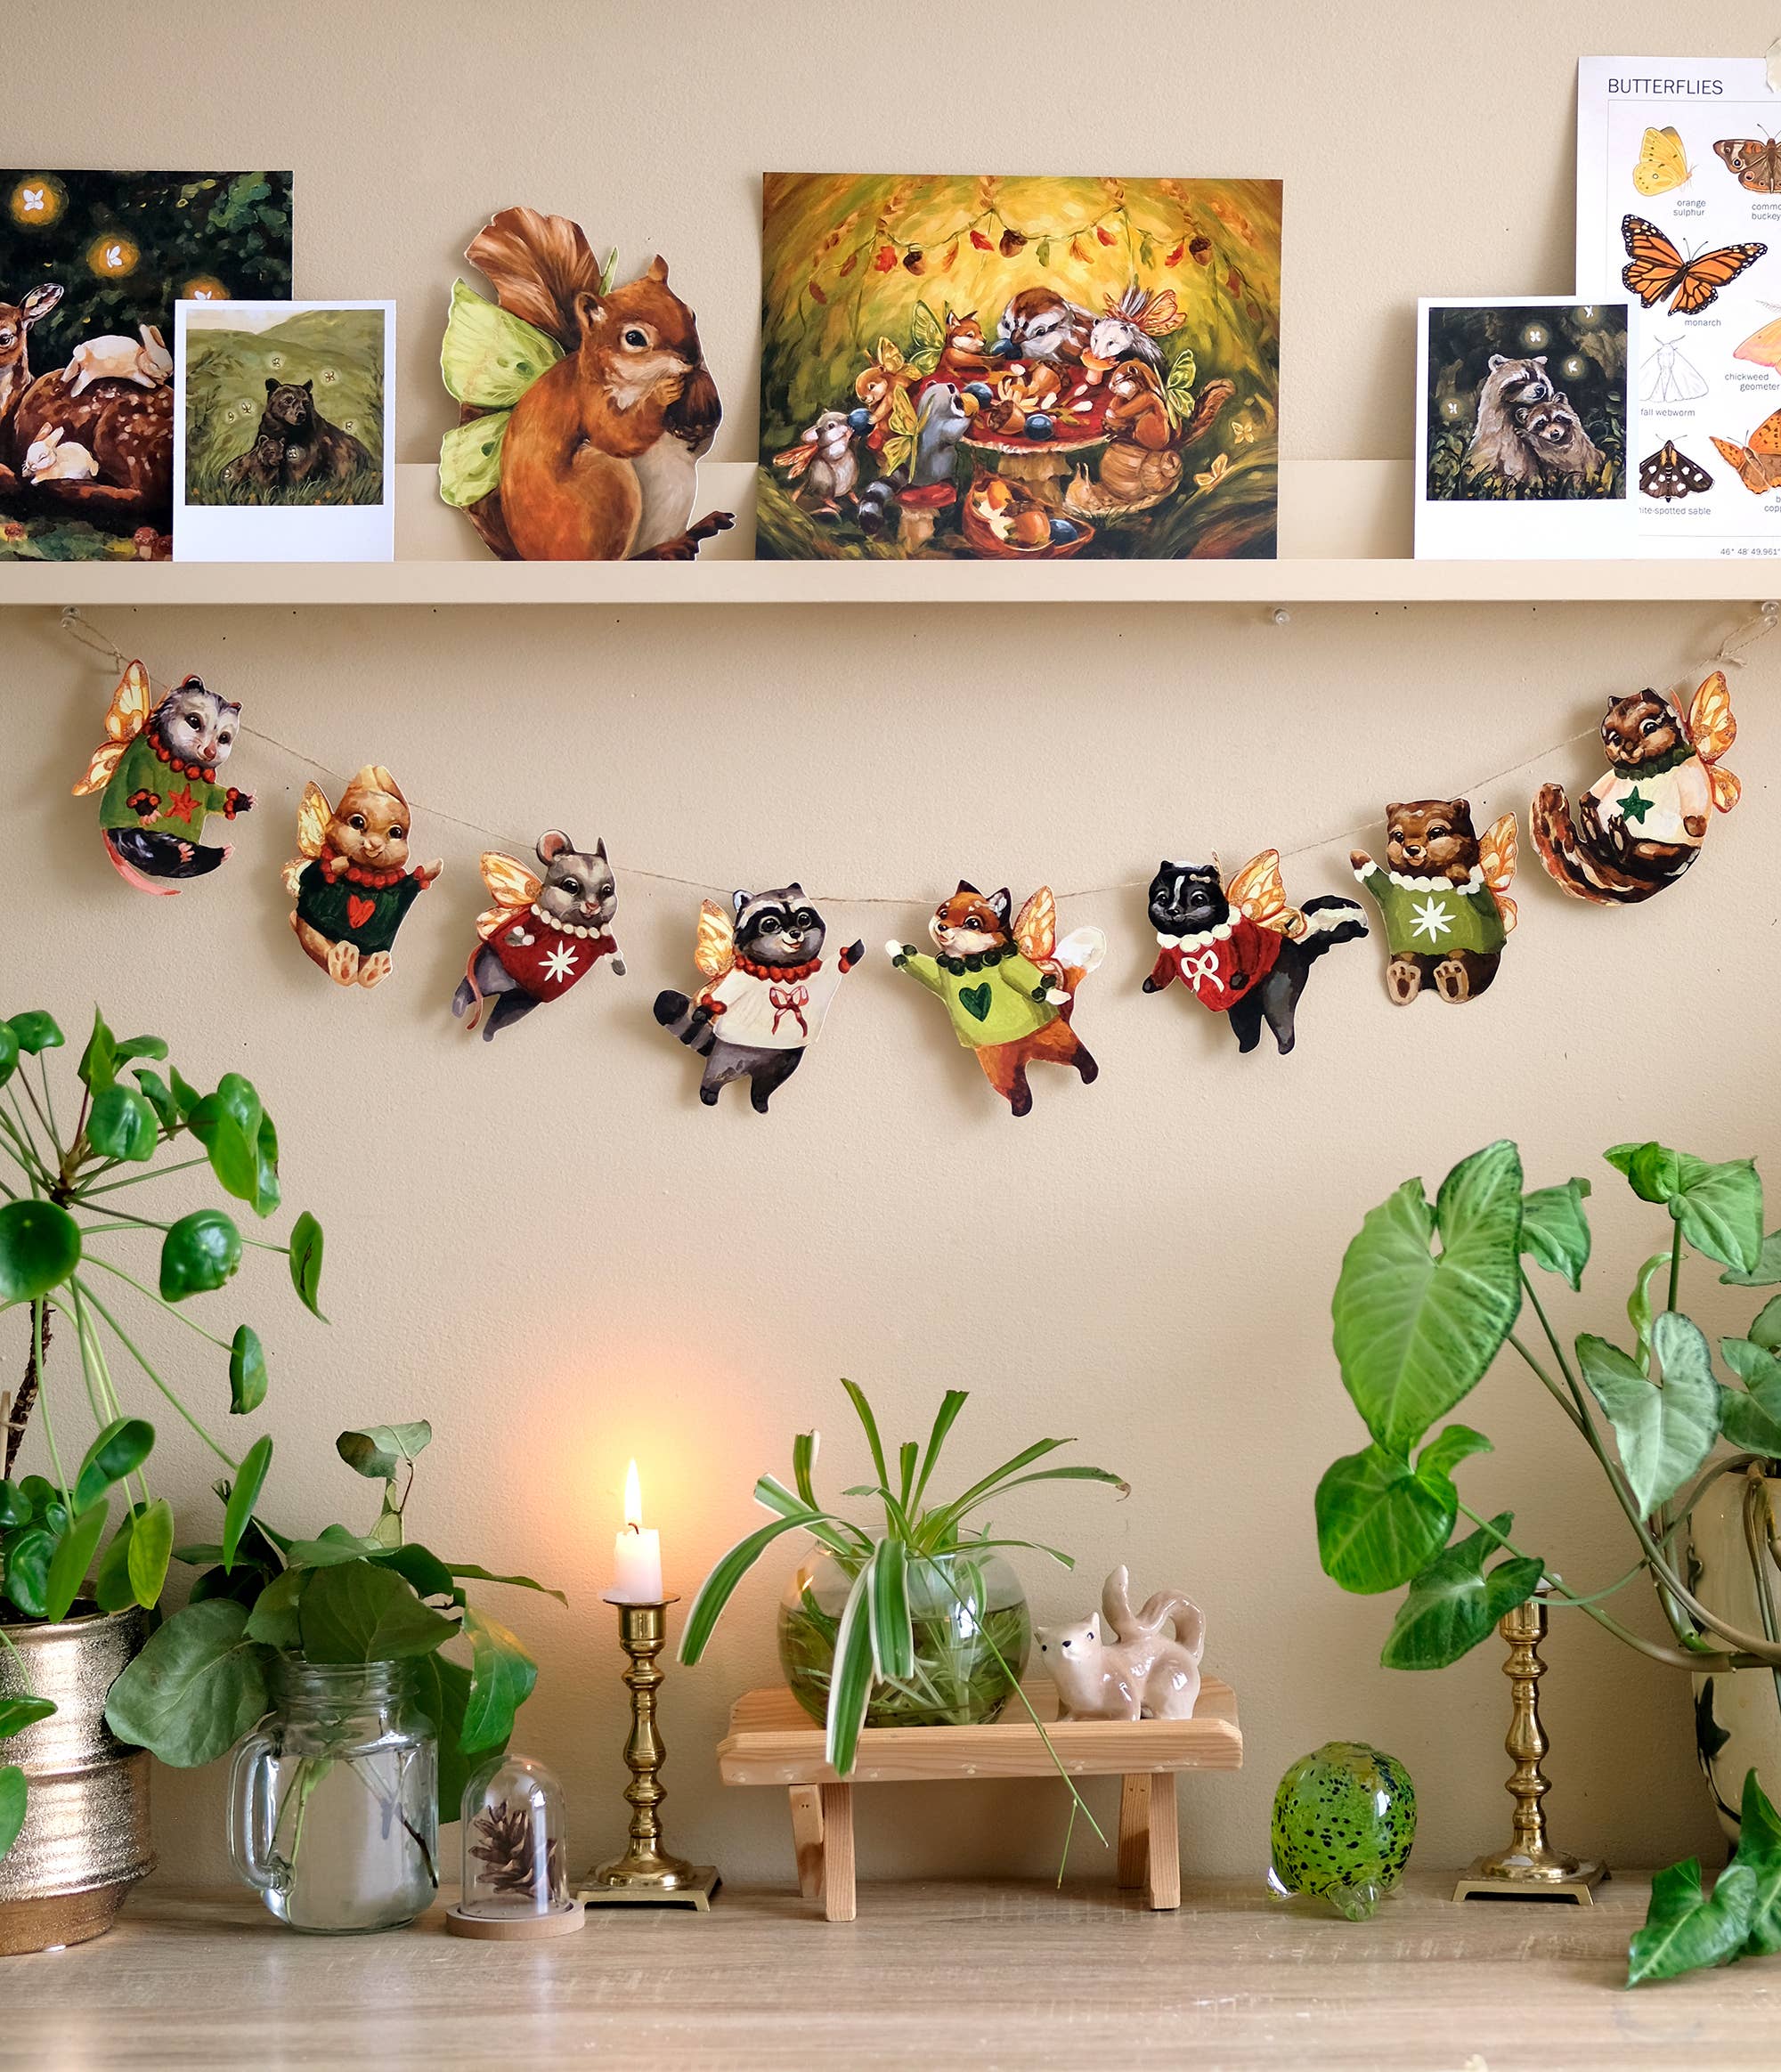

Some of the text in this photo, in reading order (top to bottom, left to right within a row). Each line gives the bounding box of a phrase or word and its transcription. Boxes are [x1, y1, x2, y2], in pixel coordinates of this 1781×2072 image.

[1607, 78, 1723, 94] BUTTERFLIES
[1676, 199, 1706, 208] orange
[1672, 208, 1705, 217] sulphur
[1684, 319, 1721, 327] monarch
[1724, 373, 1769, 381] chickweed
[1739, 383, 1780, 392] geometer
[1640, 408, 1696, 417] fall webworm
[1687, 507, 1712, 515] sable
